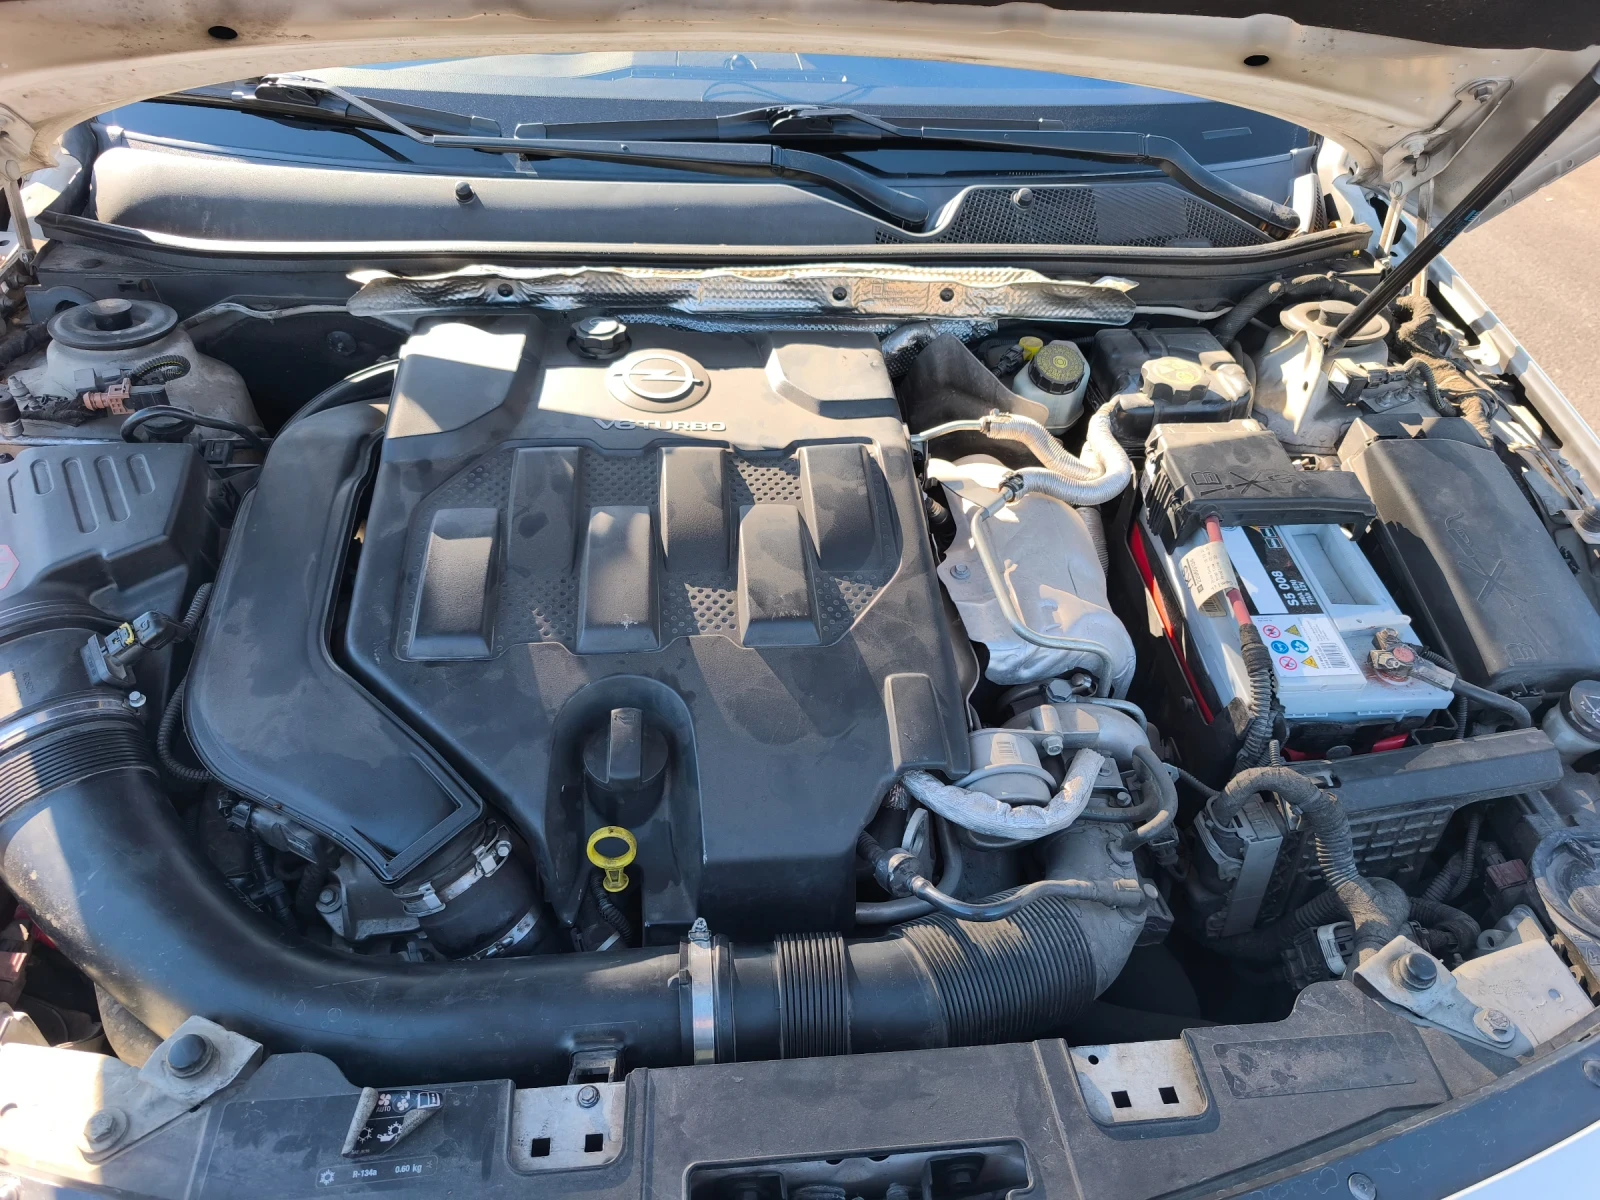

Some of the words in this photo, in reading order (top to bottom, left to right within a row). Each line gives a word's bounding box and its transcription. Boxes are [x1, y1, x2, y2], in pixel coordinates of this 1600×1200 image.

[636, 419, 727, 432] TURBO
[1271, 570, 1291, 590] 008
[1283, 592, 1300, 606] S5
[375, 1105, 391, 1113] AUTO
[352, 1168, 378, 1179] R-134a
[395, 1164, 410, 1174] 0.60
[412, 1163, 422, 1173] kg
